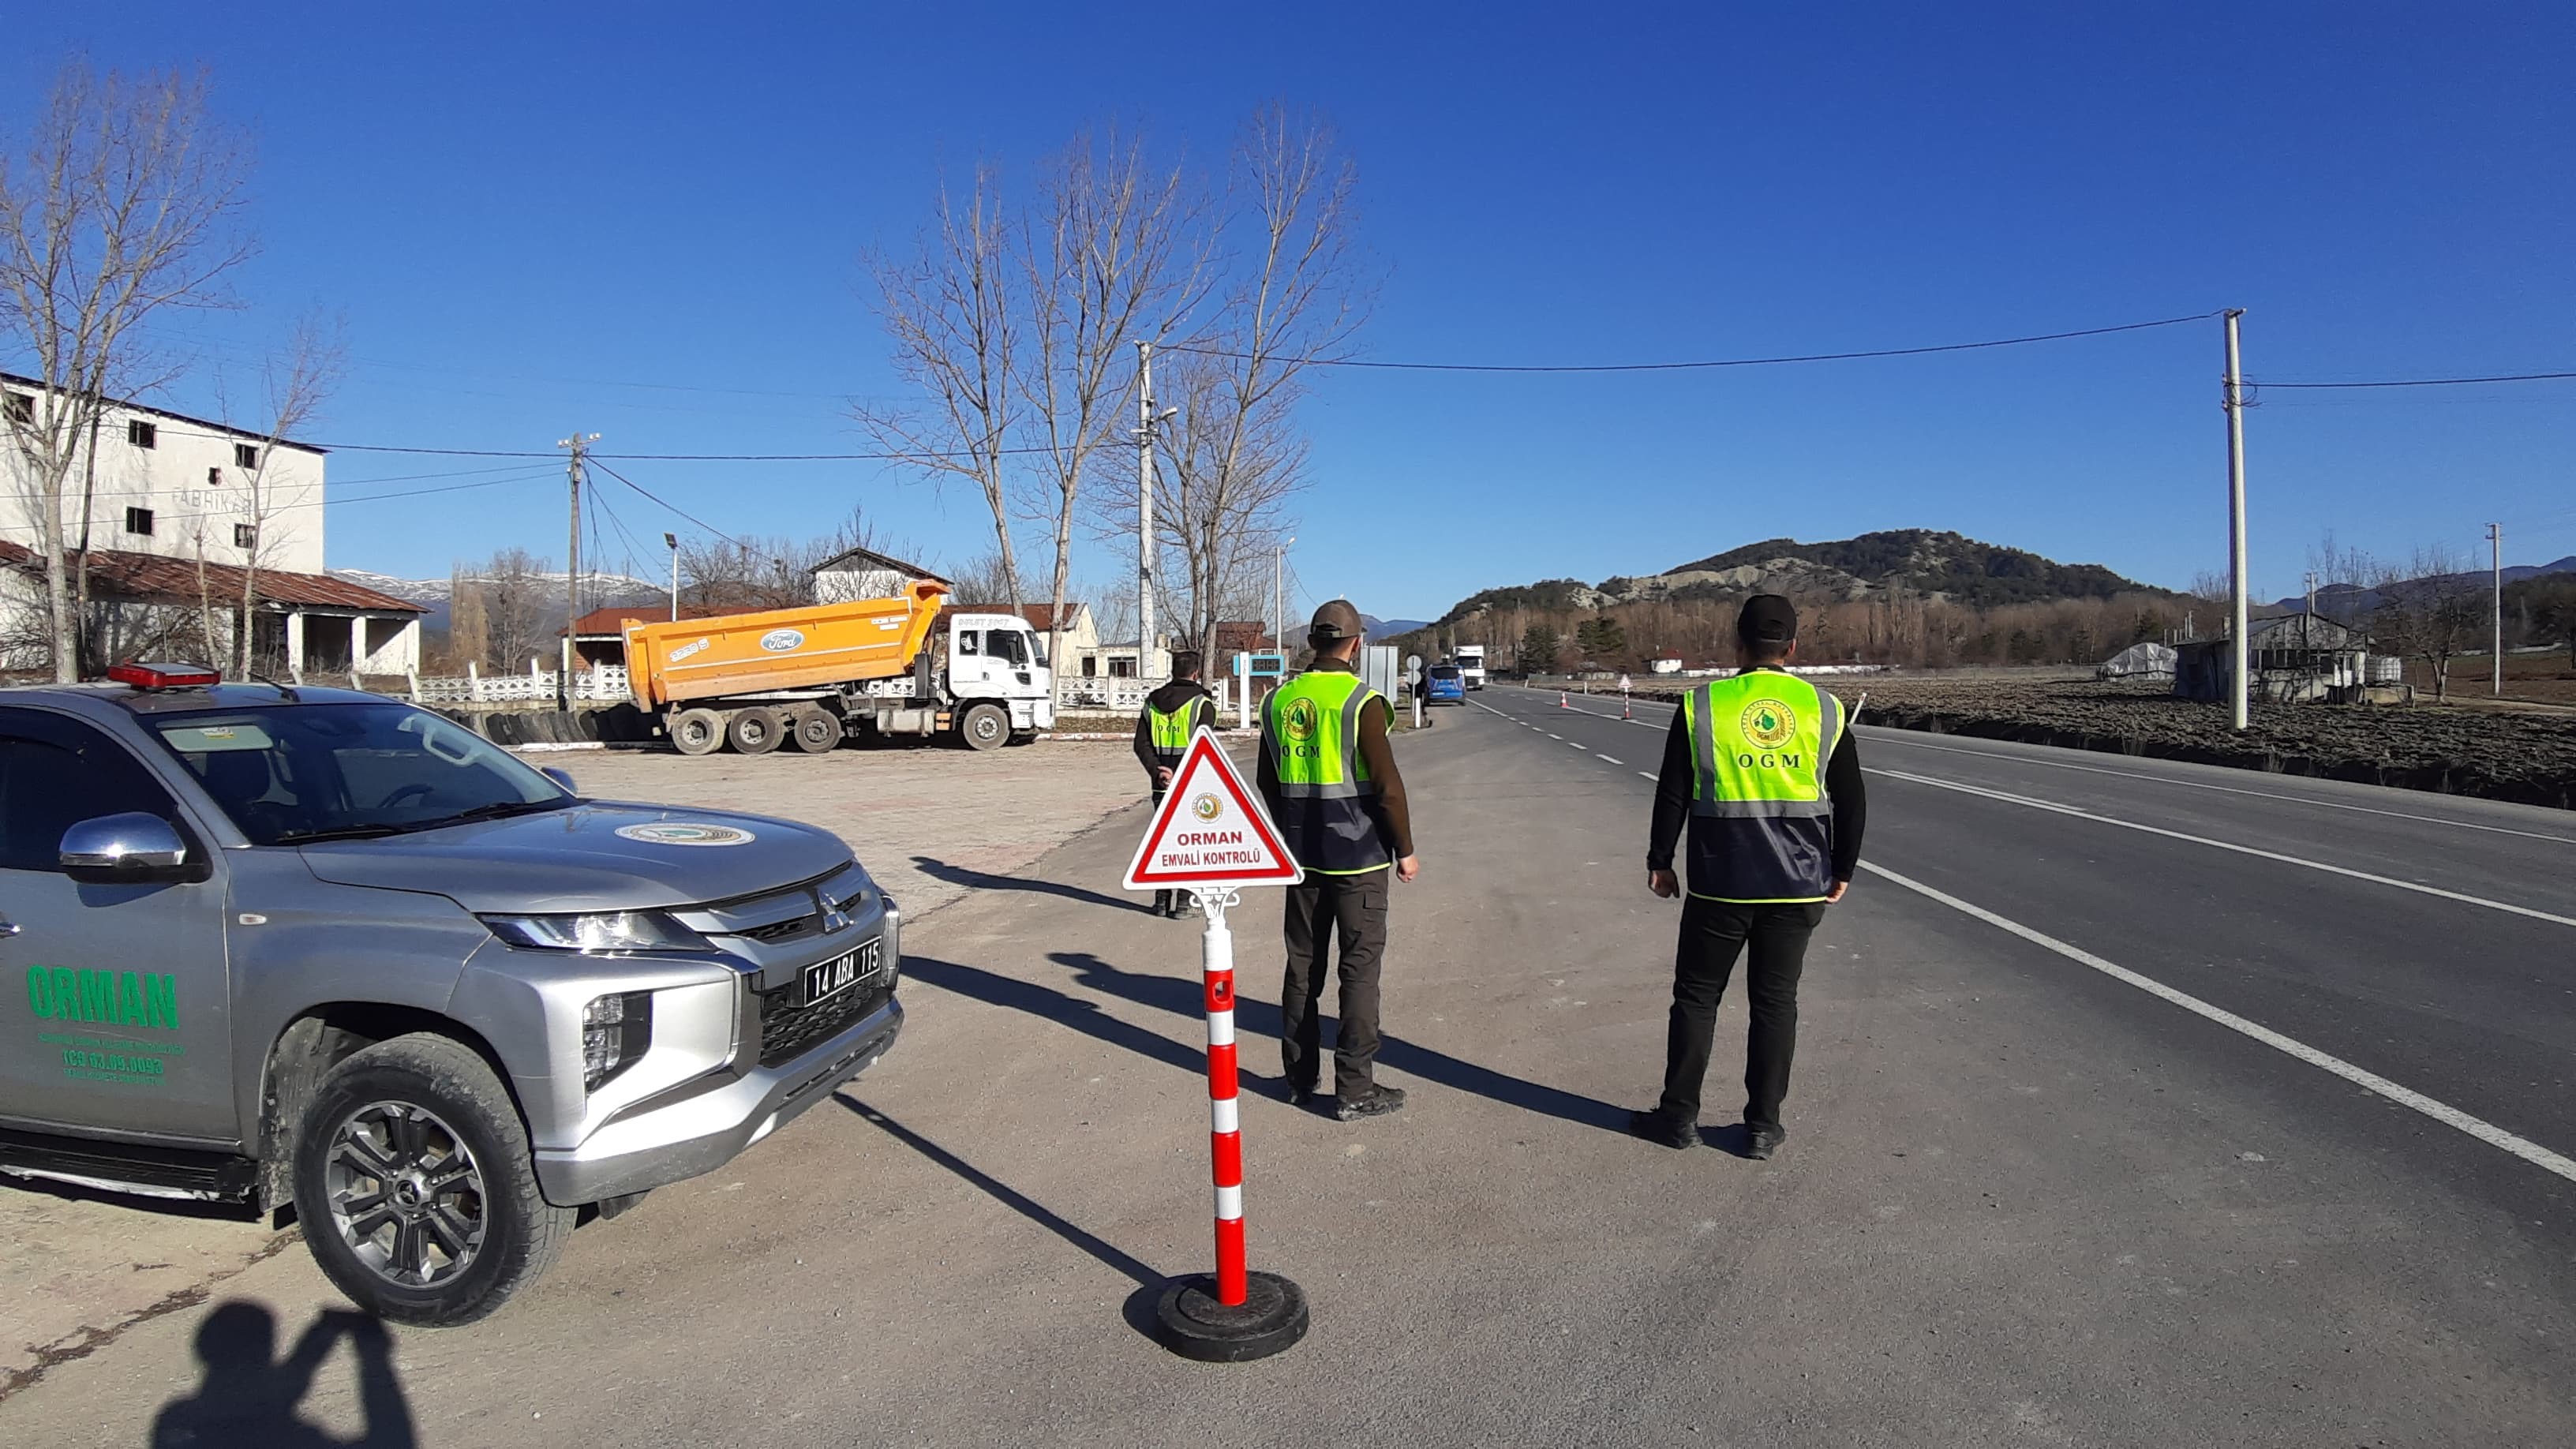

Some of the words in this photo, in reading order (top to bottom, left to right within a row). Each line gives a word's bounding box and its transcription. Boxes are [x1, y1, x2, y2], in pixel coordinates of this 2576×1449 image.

[768, 633, 796, 649] Ford
[1282, 745, 1320, 758] OGM
[1738, 754, 1800, 769] OGM
[1177, 831, 1243, 846] ORMAN
[1162, 848, 1200, 867] EMVALİ
[1204, 848, 1260, 866] KONTROLÜ
[814, 965, 829, 998] 14
[833, 954, 854, 988] ABA
[861, 942, 880, 974] 115
[27, 964, 179, 1029] ORMAN
